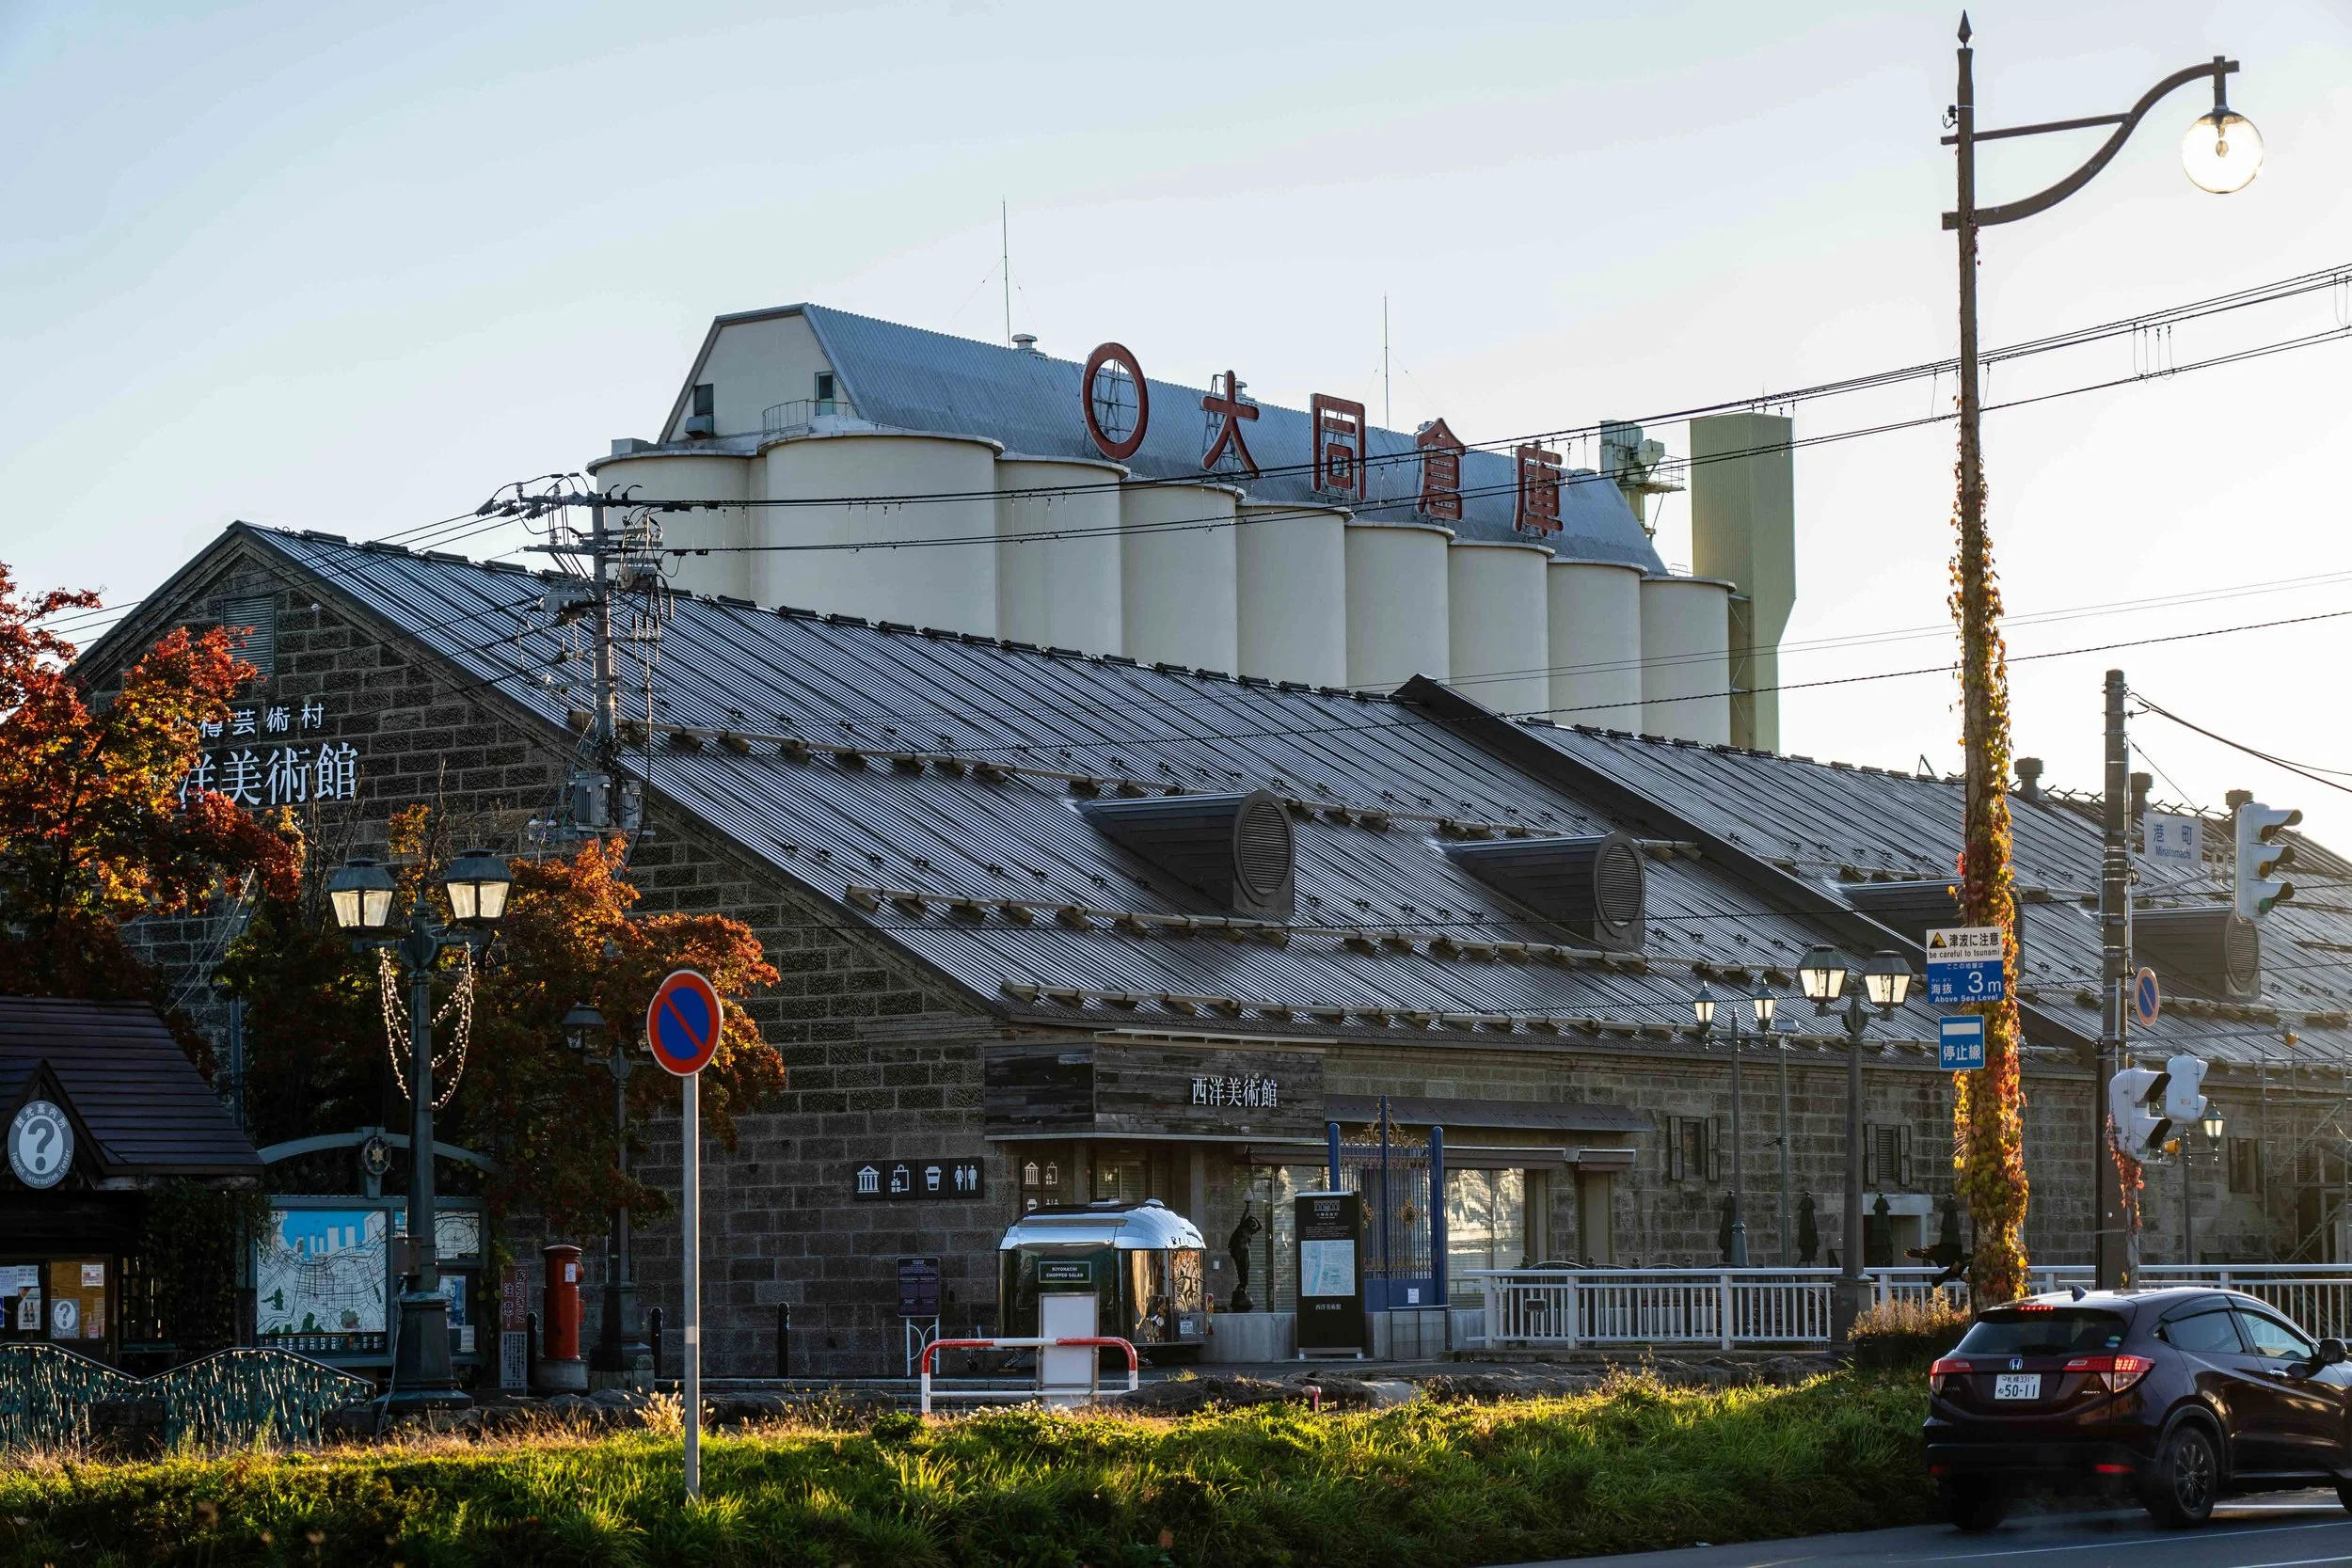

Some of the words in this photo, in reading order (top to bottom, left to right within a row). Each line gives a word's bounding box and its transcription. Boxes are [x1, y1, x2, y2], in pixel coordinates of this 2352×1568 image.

[178, 702, 325, 739] 樽芸術村
[177, 741, 359, 810] 洋美術館
[2153, 822, 2193, 846] 港町
[2155, 845, 2192, 860] Minatomachi
[1948, 932, 1999, 948] 津波に注意
[1939, 949, 1963, 958] careful
[1964, 949, 1972, 958] to
[1974, 947, 2000, 957] tsunami
[1931, 983, 1952, 994] 海抜
[1967, 971, 1984, 993] 3
[1988, 980, 2001, 992] m
[1978, 993, 1998, 1002] Level
[1943, 1043, 1981, 1061] 停止線
[1191, 1076, 1278, 1108] 西洋美術館
[25, 1172, 59, 1185] Information
[58, 1148, 72, 1173] Center
[515, 1270, 526, 1324] 客引きに
[2004, 1384, 2036, 1397] 50-11
